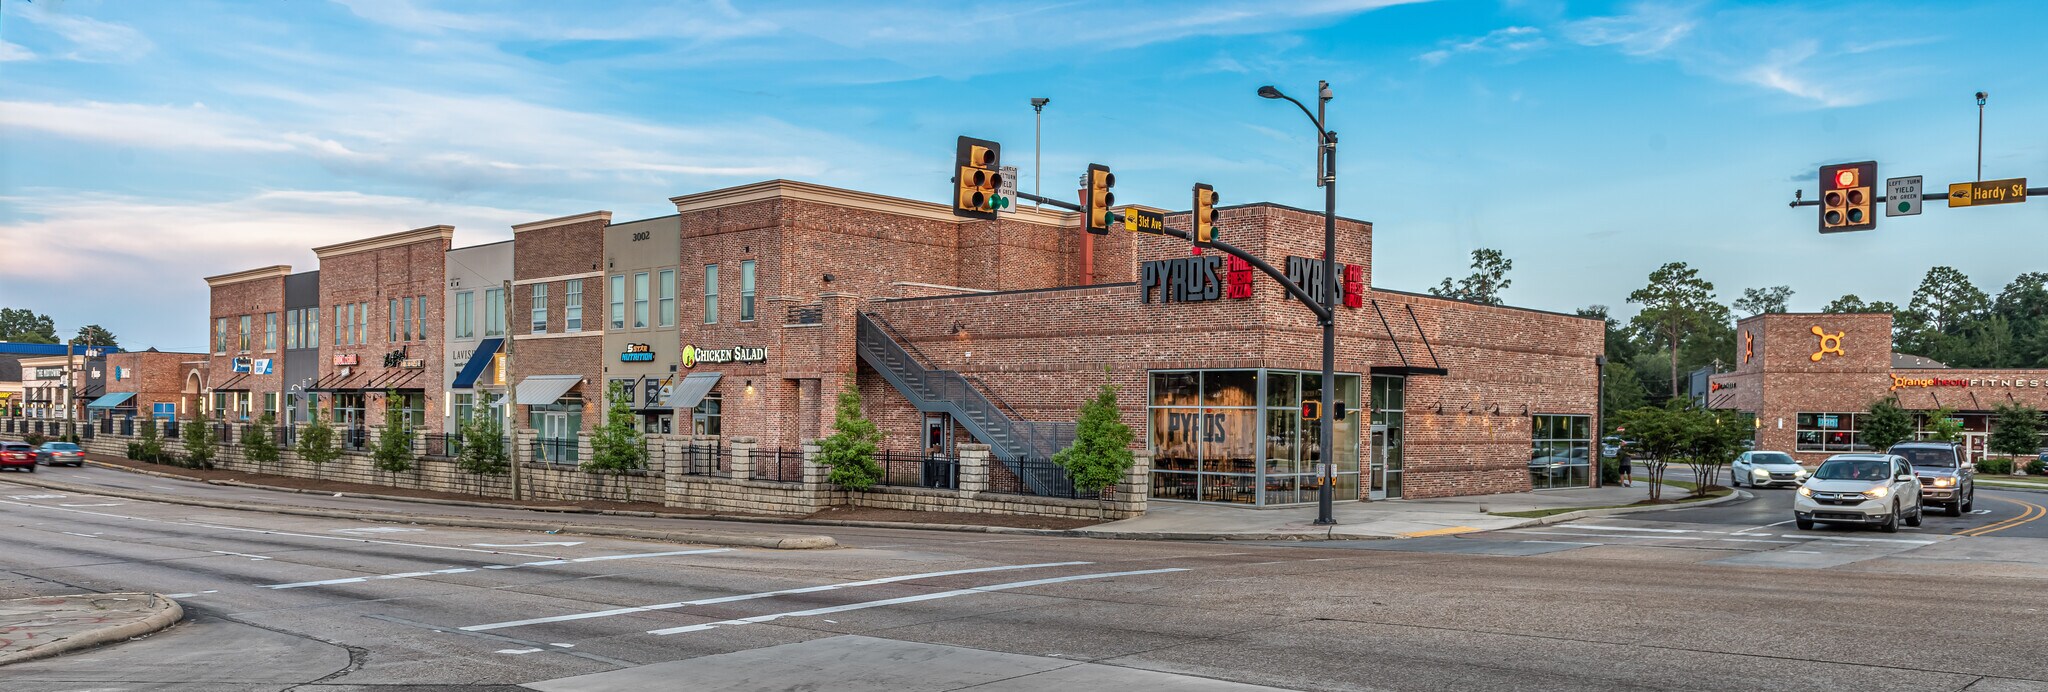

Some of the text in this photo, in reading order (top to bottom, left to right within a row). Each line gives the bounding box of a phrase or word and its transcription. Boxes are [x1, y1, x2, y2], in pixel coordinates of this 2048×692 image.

[1973, 184, 2024, 201] Hardy St
[1138, 215, 1162, 230] 31st Ave
[633, 231, 650, 241] 3002
[1141, 255, 1221, 304] PYROS
[1288, 256, 1344, 305] PYRS
[1227, 284, 1252, 299] PIZZA
[621, 352, 653, 361] NUTRITION
[694, 348, 732, 363] CHICKEN
[735, 346, 763, 361] SALAD
[1169, 411, 1226, 443] PYROS
